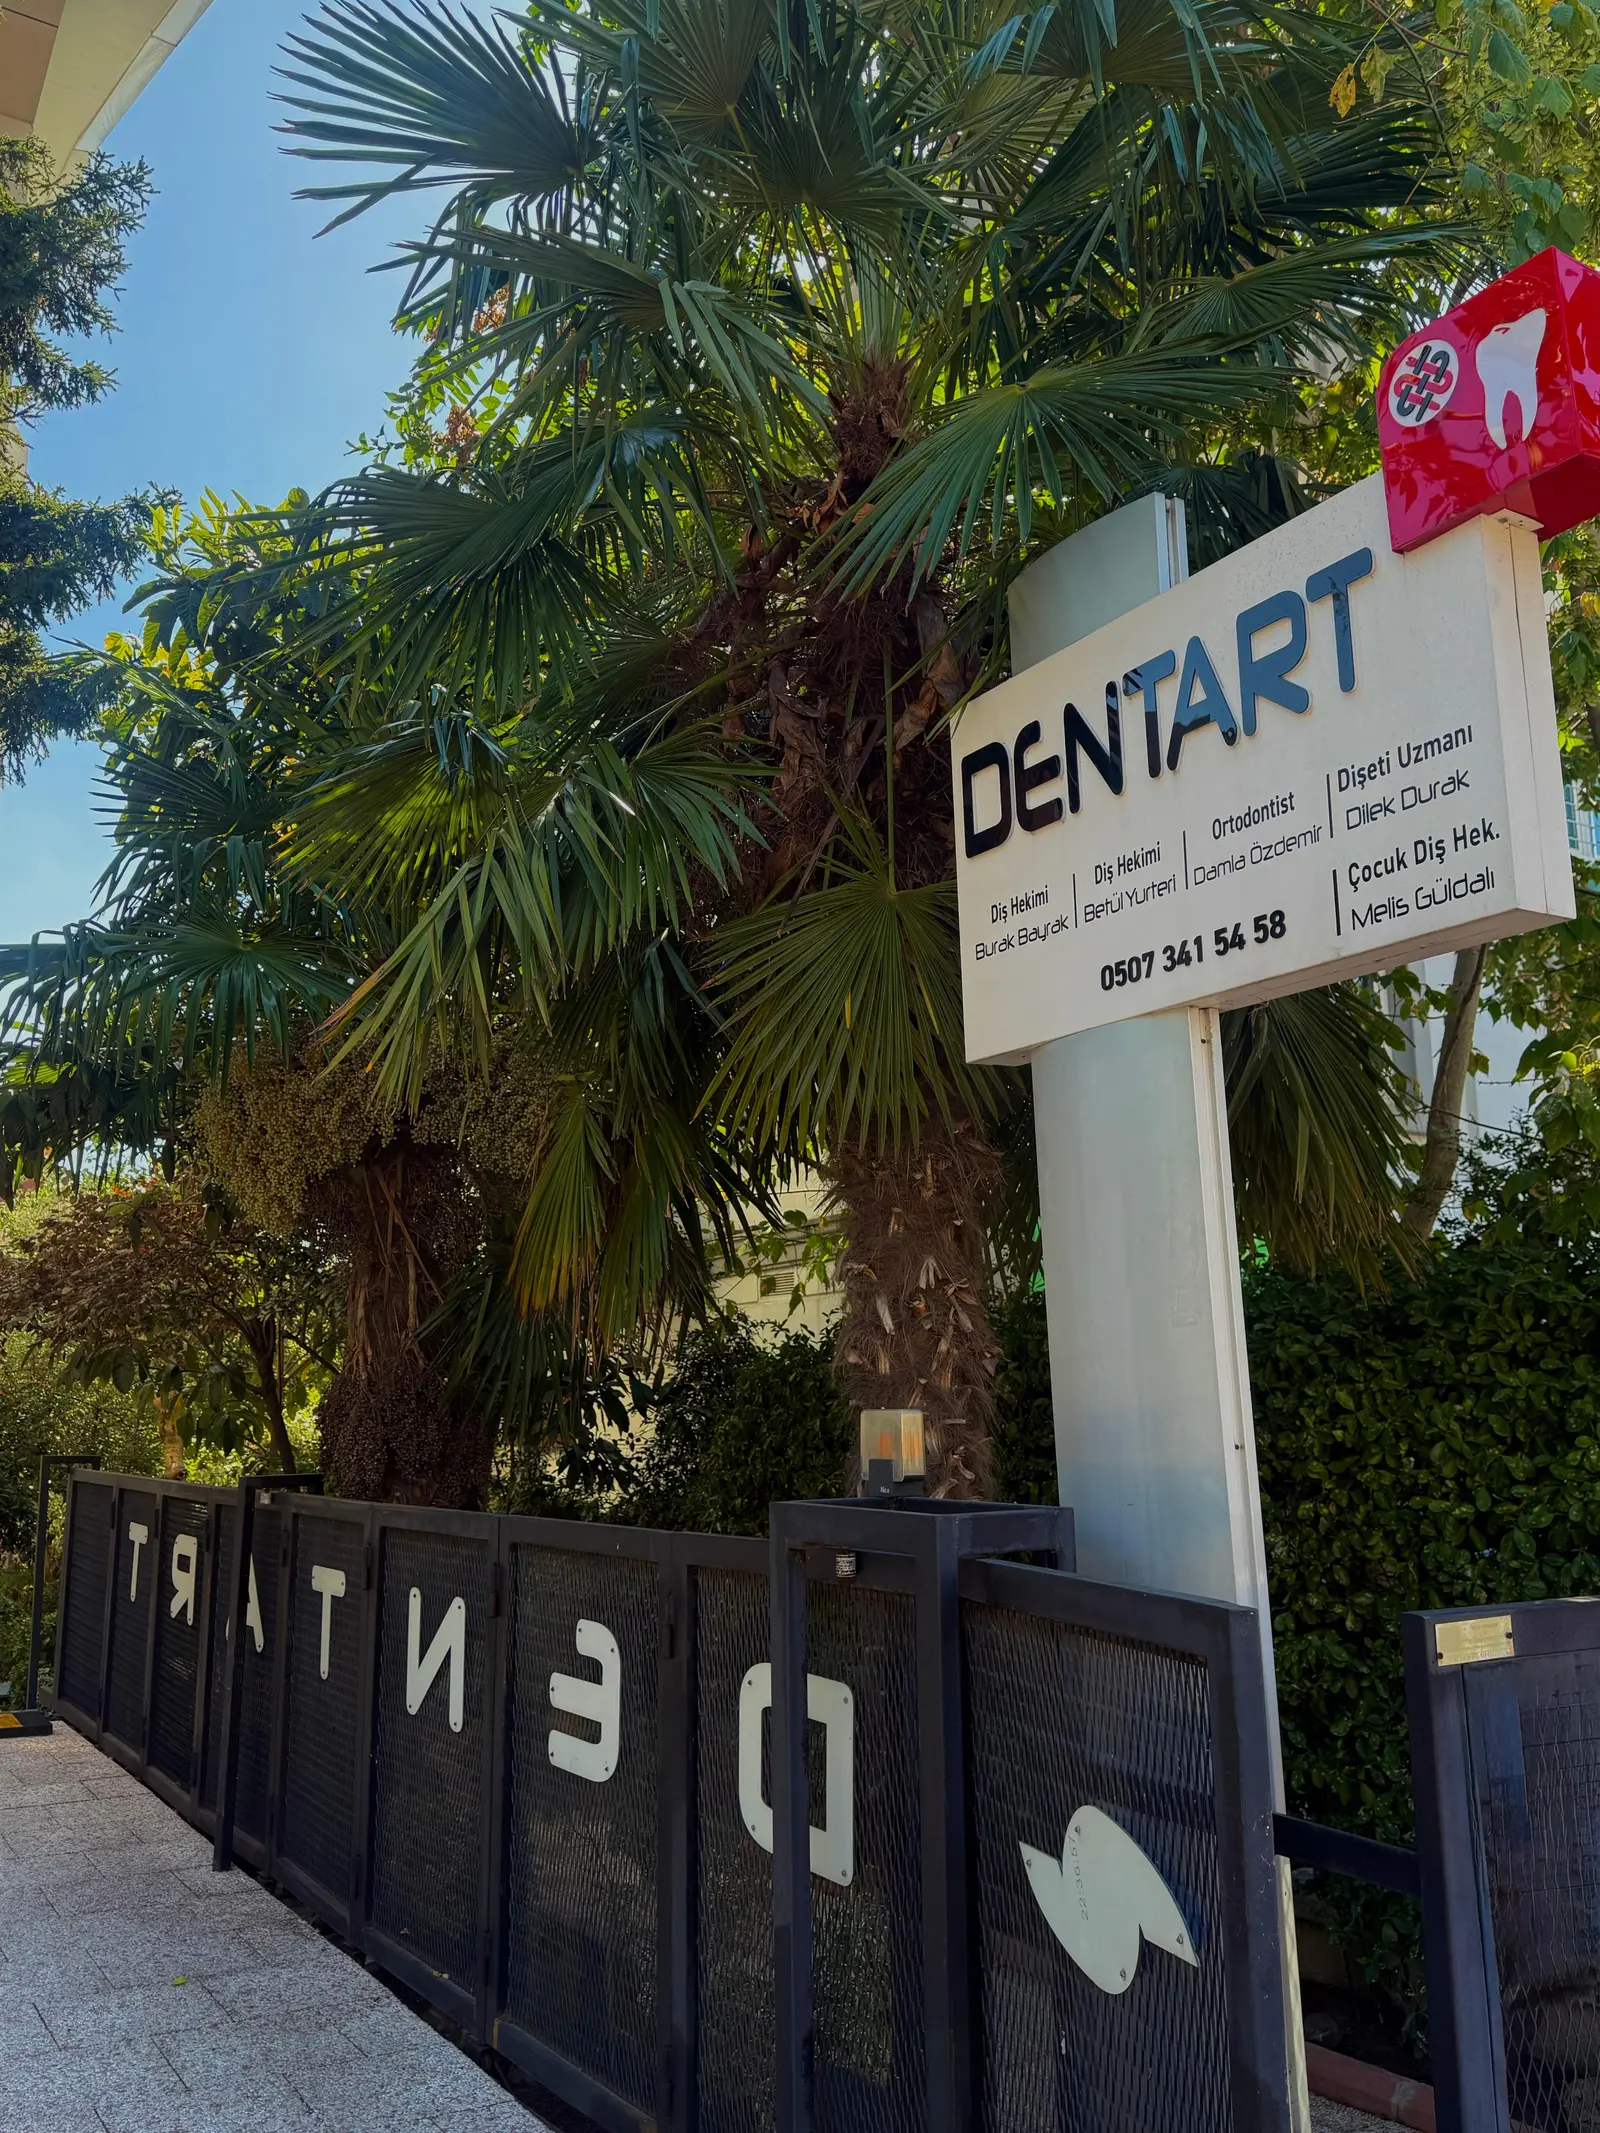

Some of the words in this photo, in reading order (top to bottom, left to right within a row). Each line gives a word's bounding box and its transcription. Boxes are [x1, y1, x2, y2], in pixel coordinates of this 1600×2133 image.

[960, 547, 1373, 858] DENTART
[1337, 751, 1391, 793] Dişeti
[1397, 724, 1473, 768] Uzmanı
[1212, 791, 1295, 840] Ortodontist
[1346, 796, 1396, 830] Dilek
[1401, 769, 1470, 811] Durak
[1094, 861, 1114, 885] Diş
[1117, 841, 1161, 877] Hekimi
[1193, 854, 1246, 886] Damla
[1250, 824, 1322, 865] Özdemir
[1348, 847, 1408, 893] Çocuk
[1413, 835, 1446, 864] Diş
[1452, 817, 1500, 852] Hek.
[991, 902, 1008, 924] Diş
[1010, 884, 1049, 916] Hekimi
[1084, 892, 1124, 923] Betül
[1124, 874, 1177, 906] Yurteri
[1351, 896, 1409, 931] Melis
[1414, 866, 1495, 910] Güldalı
[975, 933, 1015, 961] Burak
[1017, 914, 1069, 946] Bayrak
[1100, 950, 1155, 991] 0507
[1162, 935, 1204, 973] 341
[1213, 922, 1247, 956] 54
[1252, 909, 1287, 944] 58
